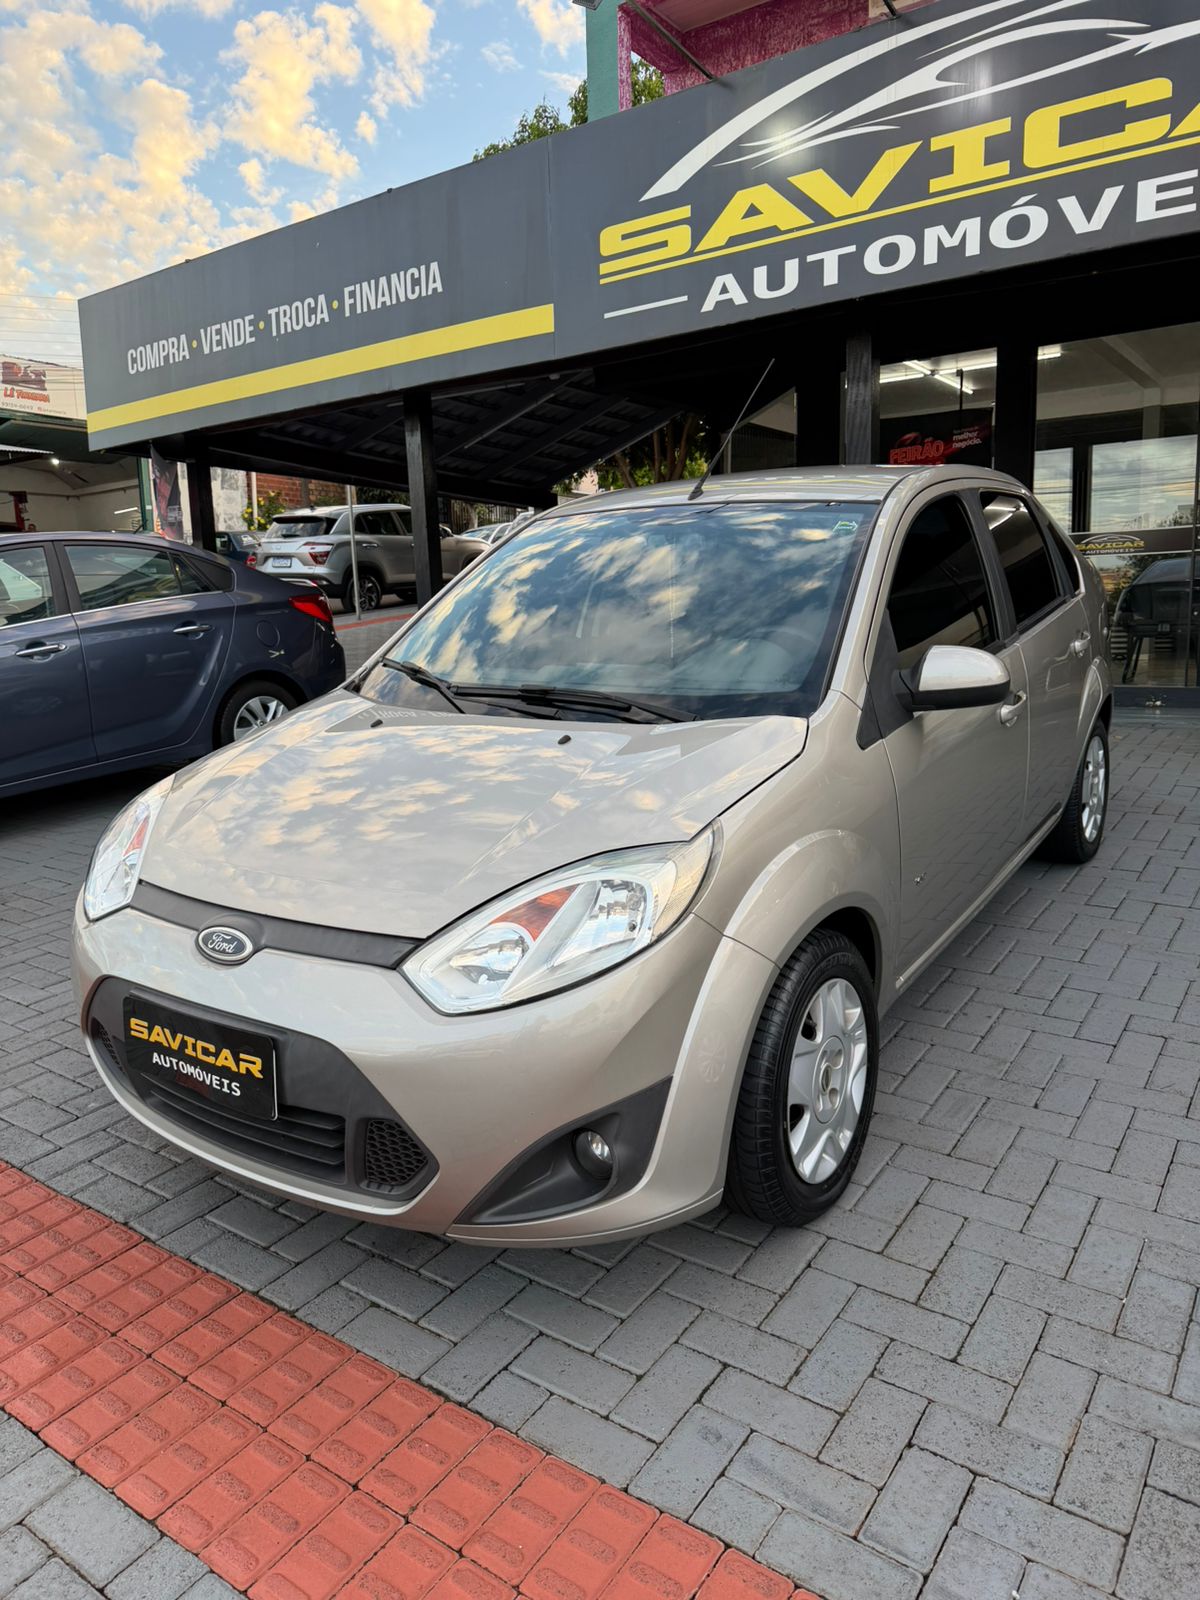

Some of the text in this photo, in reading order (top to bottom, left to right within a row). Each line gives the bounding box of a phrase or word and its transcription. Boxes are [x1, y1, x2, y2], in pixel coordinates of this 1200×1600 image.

[599, 77, 1200, 275] SAVIC
[127, 261, 444, 375] COMPRA VENDE TROCA FINANCIA
[889, 436, 944, 464] FEIRÃO
[1075, 540, 1145, 551] SAVICAR
[207, 931, 237, 954] Ford
[129, 1016, 264, 1079] SAVICAR
[152, 1051, 241, 1097] AUTOMÓVEIS
